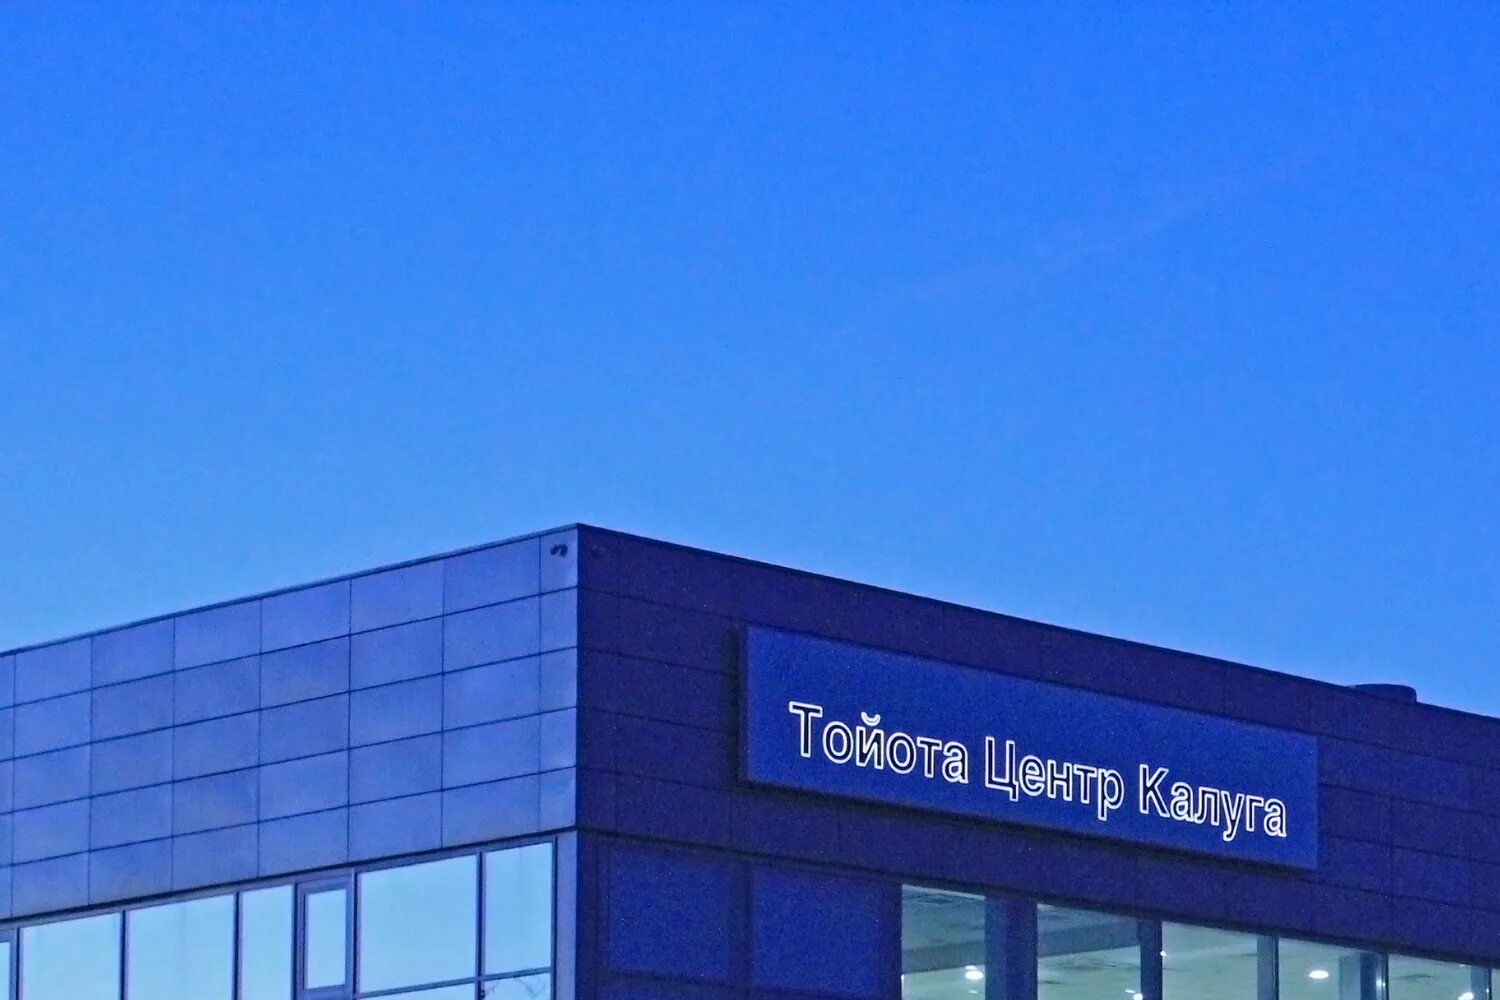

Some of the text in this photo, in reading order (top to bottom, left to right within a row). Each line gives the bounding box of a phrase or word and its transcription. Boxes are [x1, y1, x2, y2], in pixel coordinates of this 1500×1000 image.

[788, 701, 1287, 842] Тойота Центр Калуга
